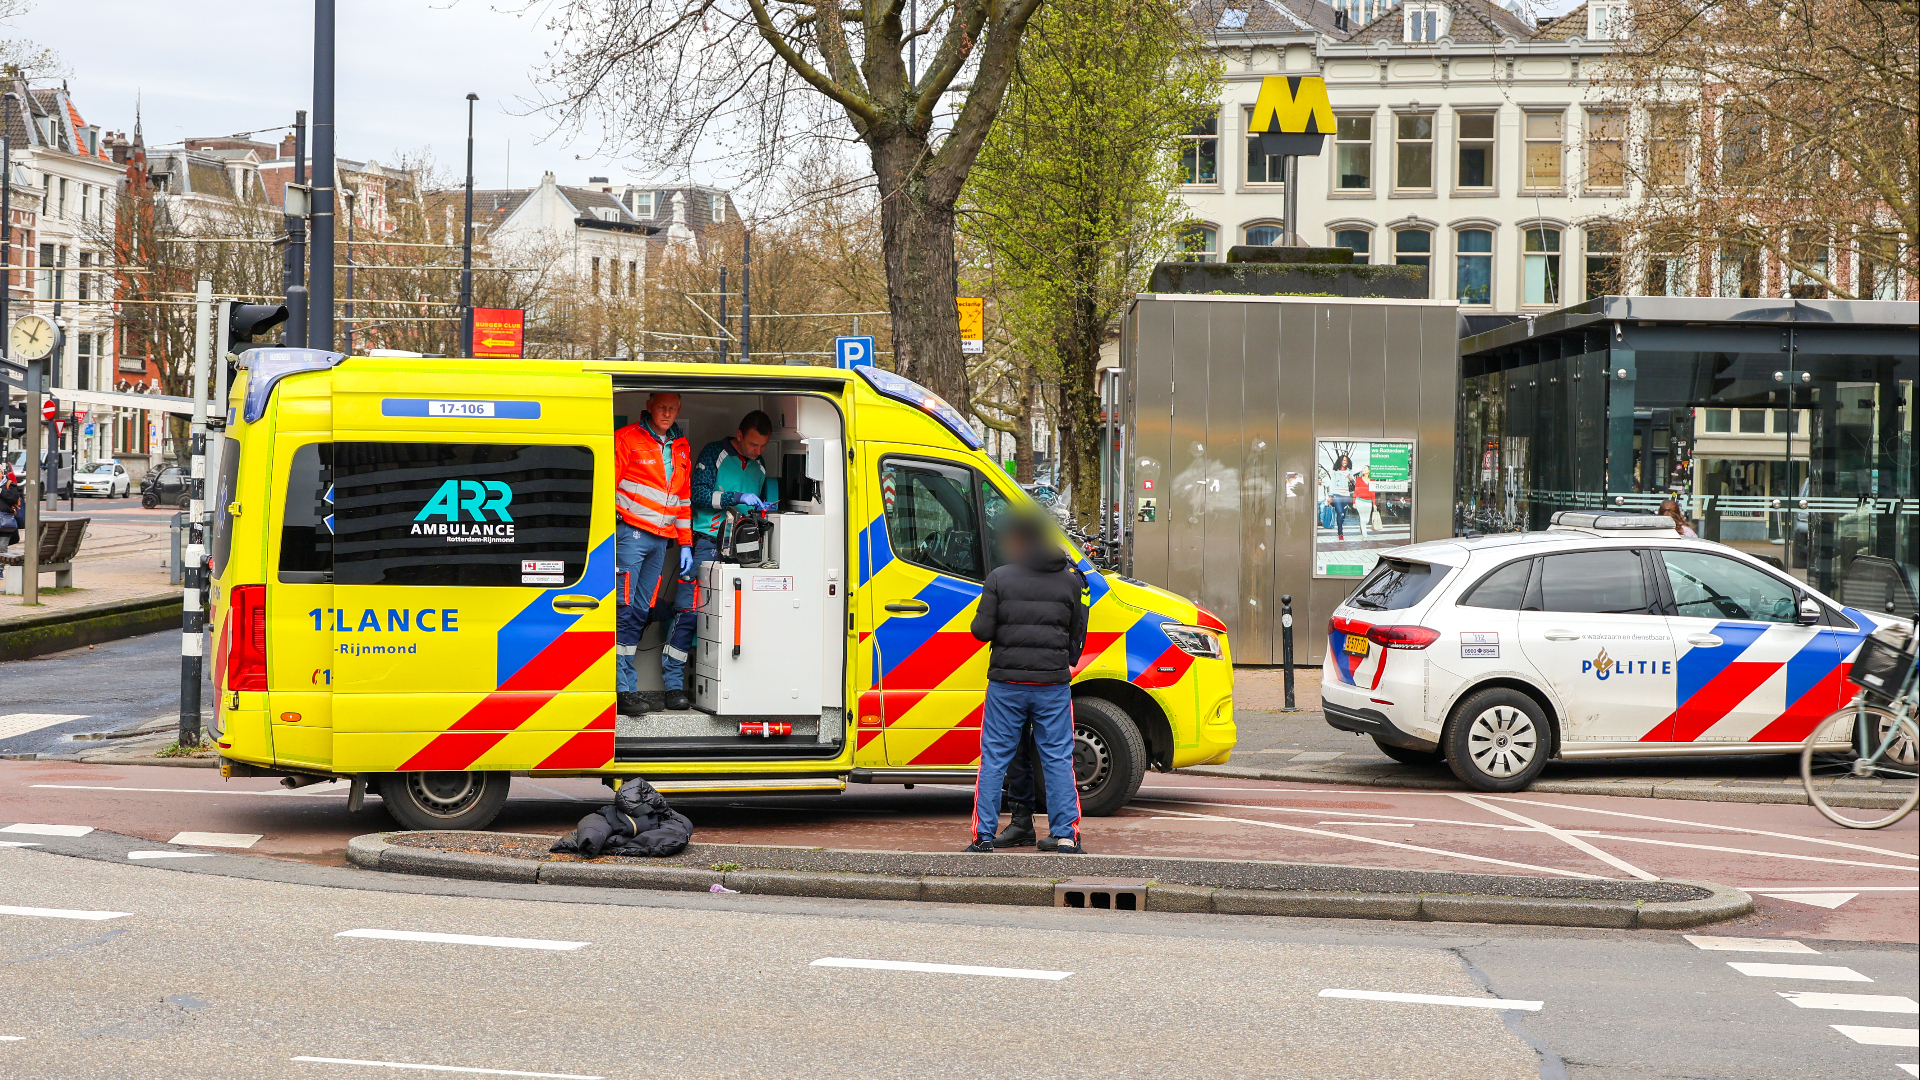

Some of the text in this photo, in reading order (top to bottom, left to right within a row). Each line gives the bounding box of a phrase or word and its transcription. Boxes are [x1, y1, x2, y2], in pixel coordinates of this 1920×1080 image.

[440, 404, 485, 414] 17-106
[413, 480, 514, 522] ARR
[411, 523, 515, 536] AMBULANCE
[446, 536, 515, 544] Rotterdam-Rijnmond
[1582, 659, 1671, 681] POLITIE
